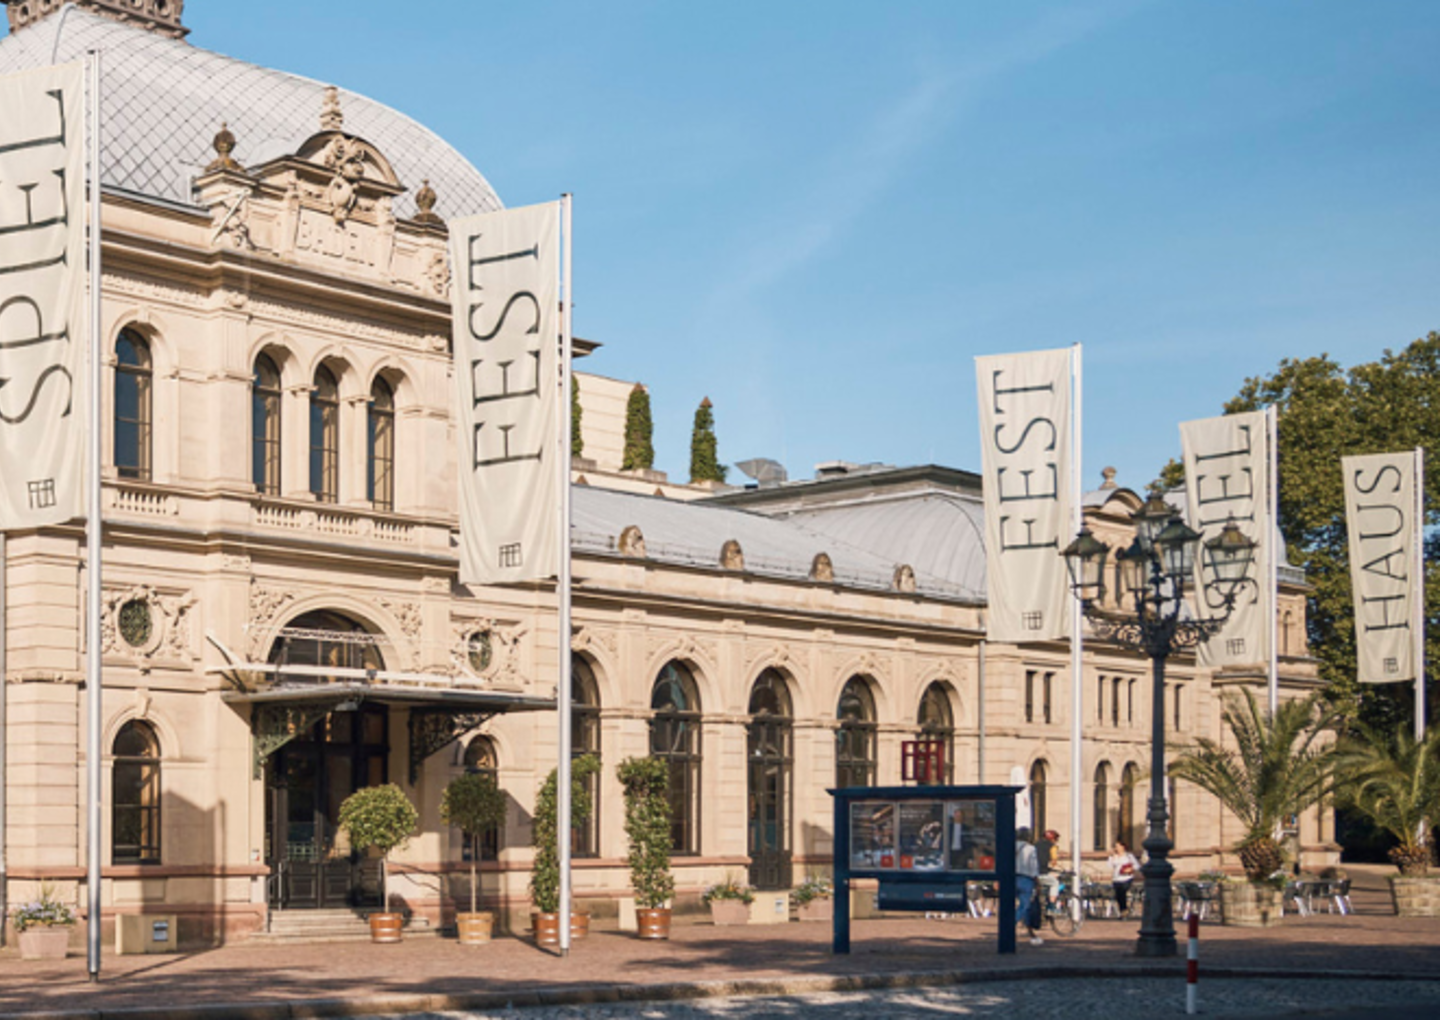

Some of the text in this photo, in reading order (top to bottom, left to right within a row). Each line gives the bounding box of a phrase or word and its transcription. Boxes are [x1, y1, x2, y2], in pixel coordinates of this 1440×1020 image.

[295, 214, 379, 268] BADEN
[468, 233, 543, 472] FEST
[993, 370, 1059, 553] FEST
[1354, 464, 1409, 633] HAUS
